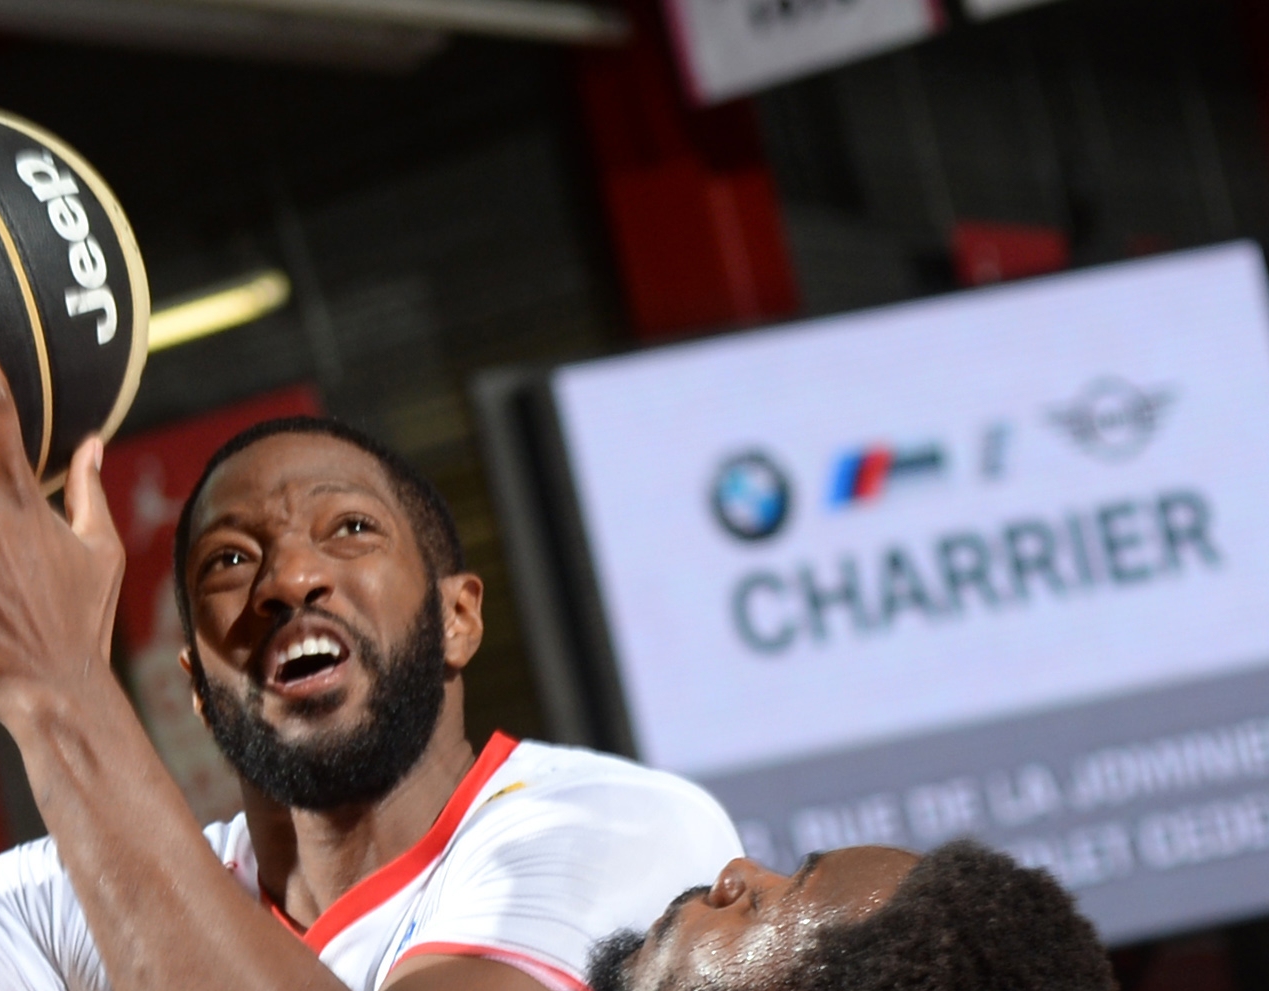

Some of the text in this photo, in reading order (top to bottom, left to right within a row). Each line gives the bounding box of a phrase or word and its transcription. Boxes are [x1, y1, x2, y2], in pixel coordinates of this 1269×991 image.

[15, 147, 118, 345] Jeep
[731, 488, 1224, 656] CHARRIER
[903, 776, 981, 842] DE
[984, 761, 1062, 828] LA
